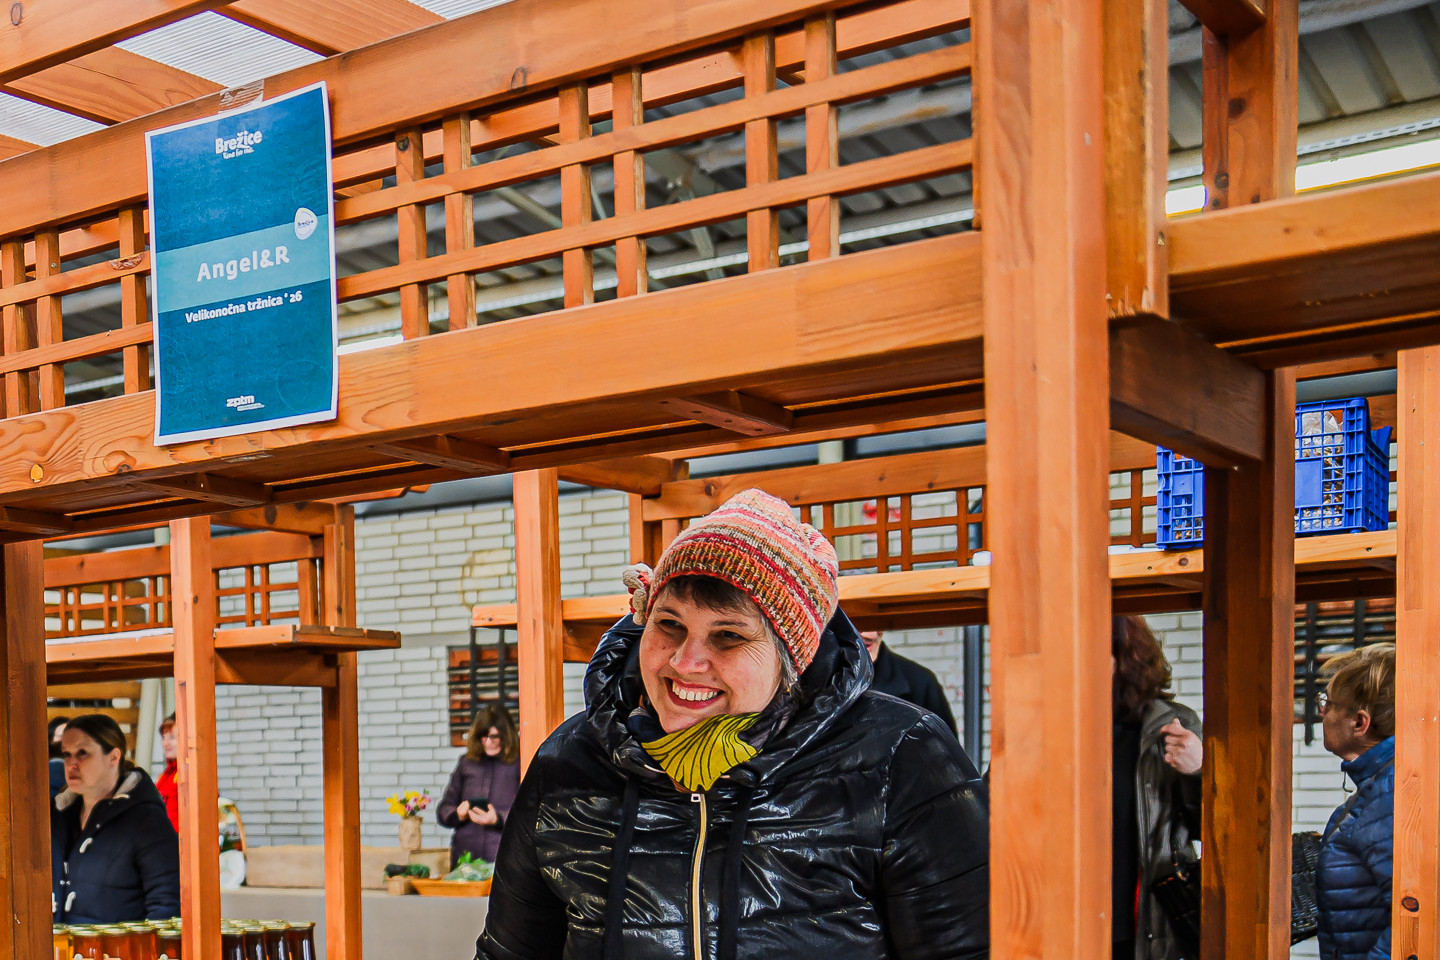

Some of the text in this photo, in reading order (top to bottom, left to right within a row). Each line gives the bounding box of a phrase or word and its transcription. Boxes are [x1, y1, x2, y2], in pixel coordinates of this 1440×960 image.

[215, 130, 263, 155] Brežice
[197, 245, 290, 282] Angel&R
[184, 303, 246, 324] Velikonočna
[246, 295, 284, 312] tržnica
